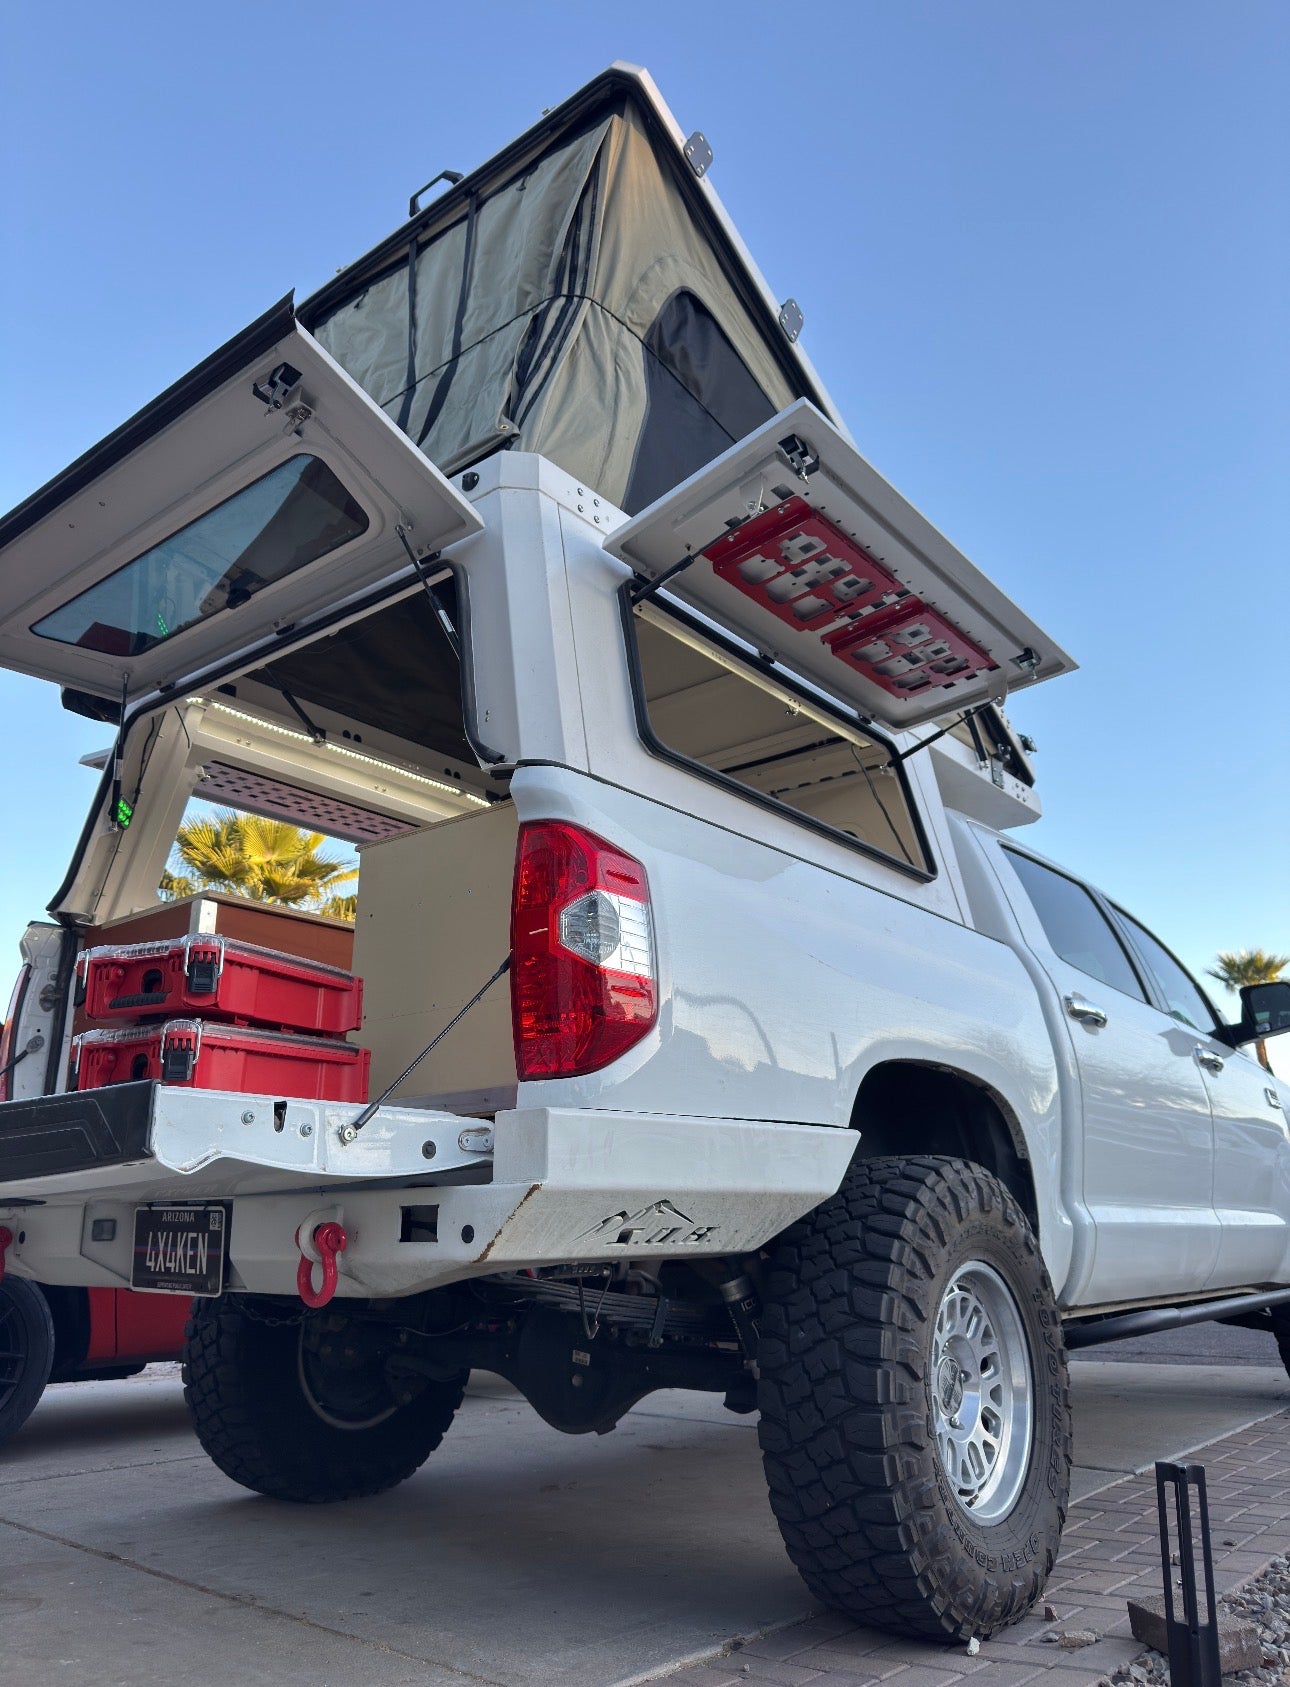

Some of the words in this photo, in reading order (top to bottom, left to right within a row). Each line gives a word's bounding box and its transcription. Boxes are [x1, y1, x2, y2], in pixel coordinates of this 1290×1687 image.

[162, 1212, 195, 1222] ARIZONA
[146, 1231, 209, 1275] 4X4KEN
[1033, 1287, 1061, 1377] TOYO
